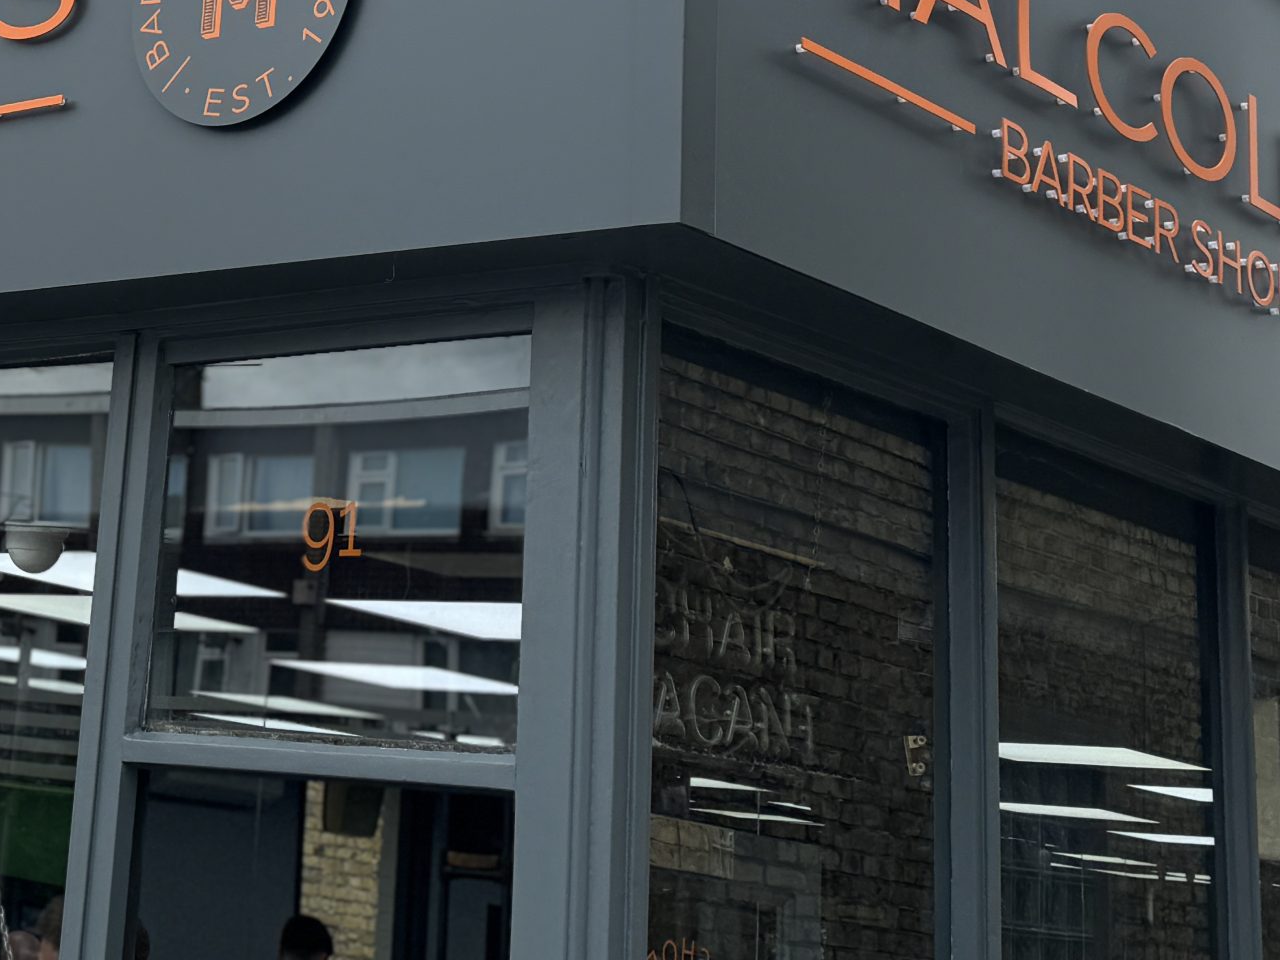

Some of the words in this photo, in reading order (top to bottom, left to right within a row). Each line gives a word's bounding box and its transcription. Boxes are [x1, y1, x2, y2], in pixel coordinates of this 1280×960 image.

[1001, 117, 1180, 264] BARBER
[1191, 219, 1280, 307] SHO
[302, 501, 362, 572] 91
